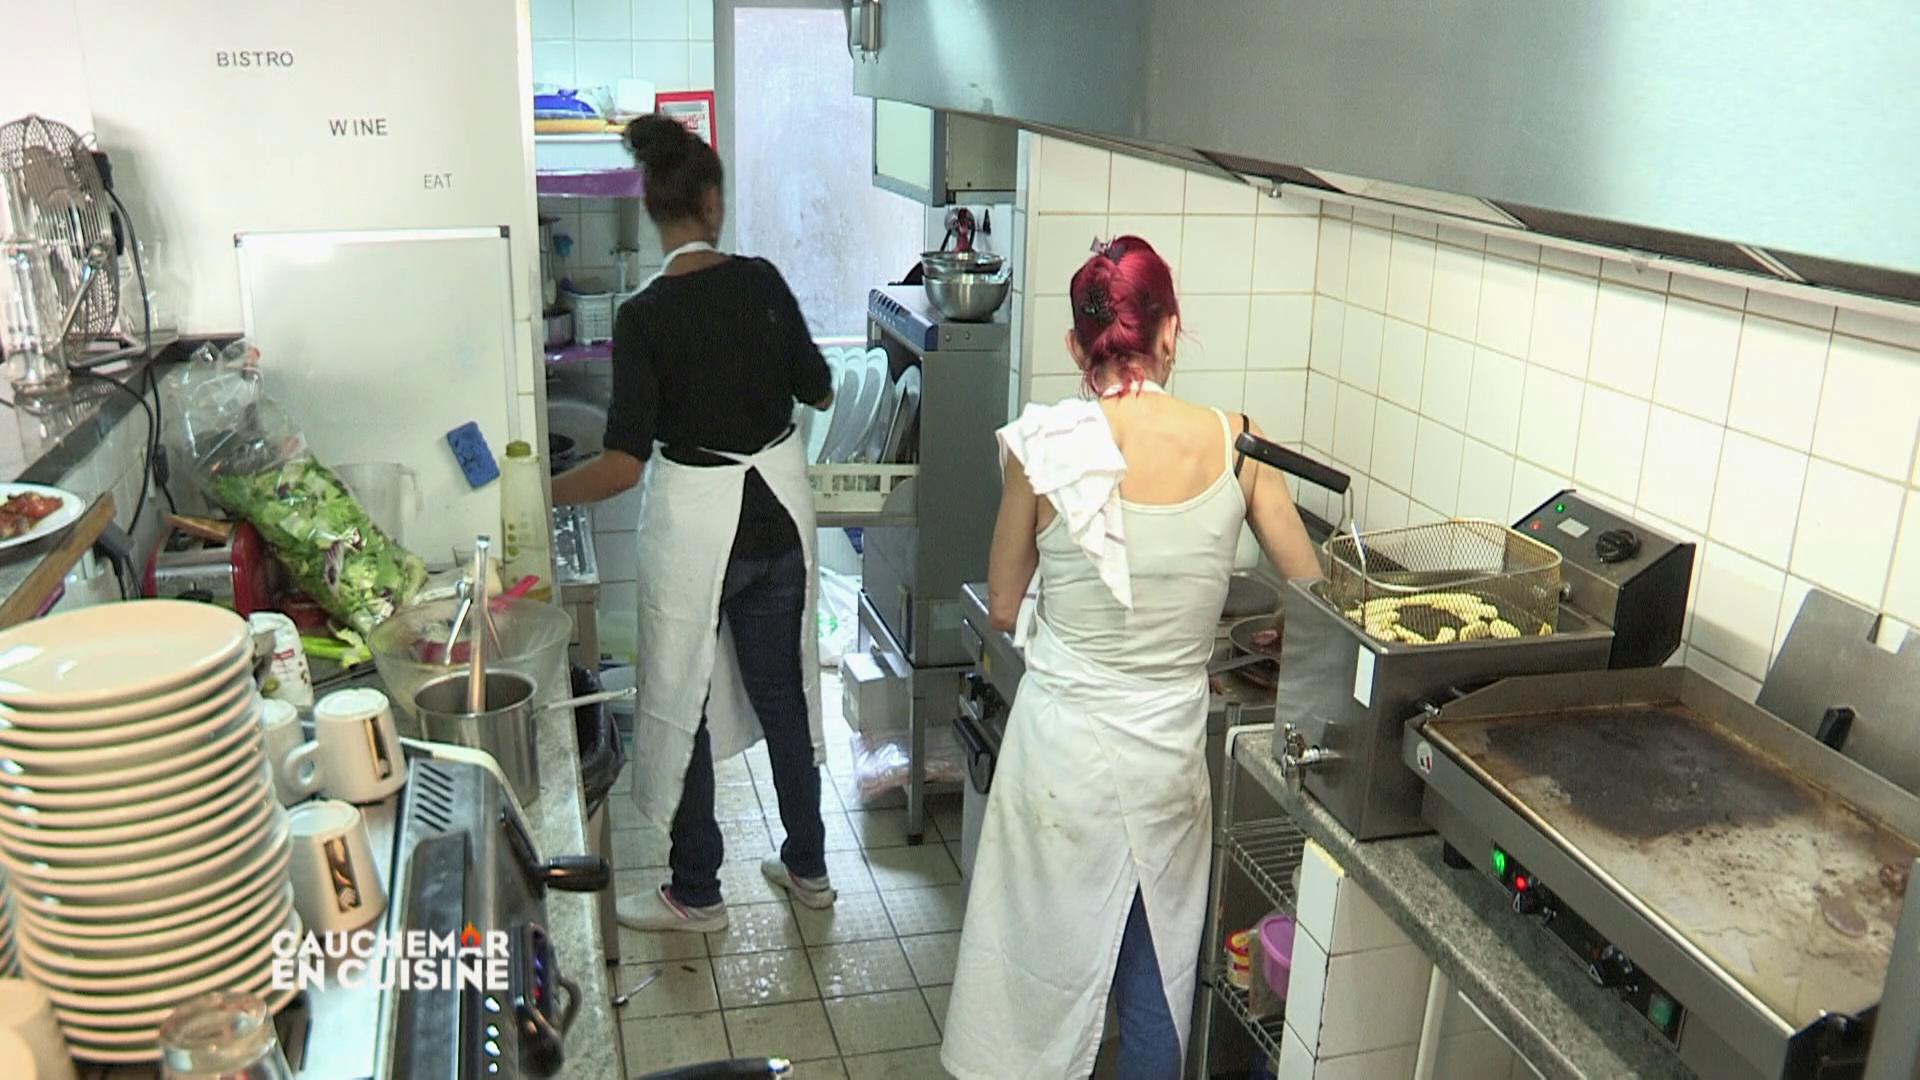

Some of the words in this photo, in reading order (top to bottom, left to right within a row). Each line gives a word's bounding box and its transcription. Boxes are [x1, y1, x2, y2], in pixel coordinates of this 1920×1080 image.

[216, 50, 294, 68] BISTRO
[329, 118, 388, 137] WINE
[423, 173, 453, 190] EAT
